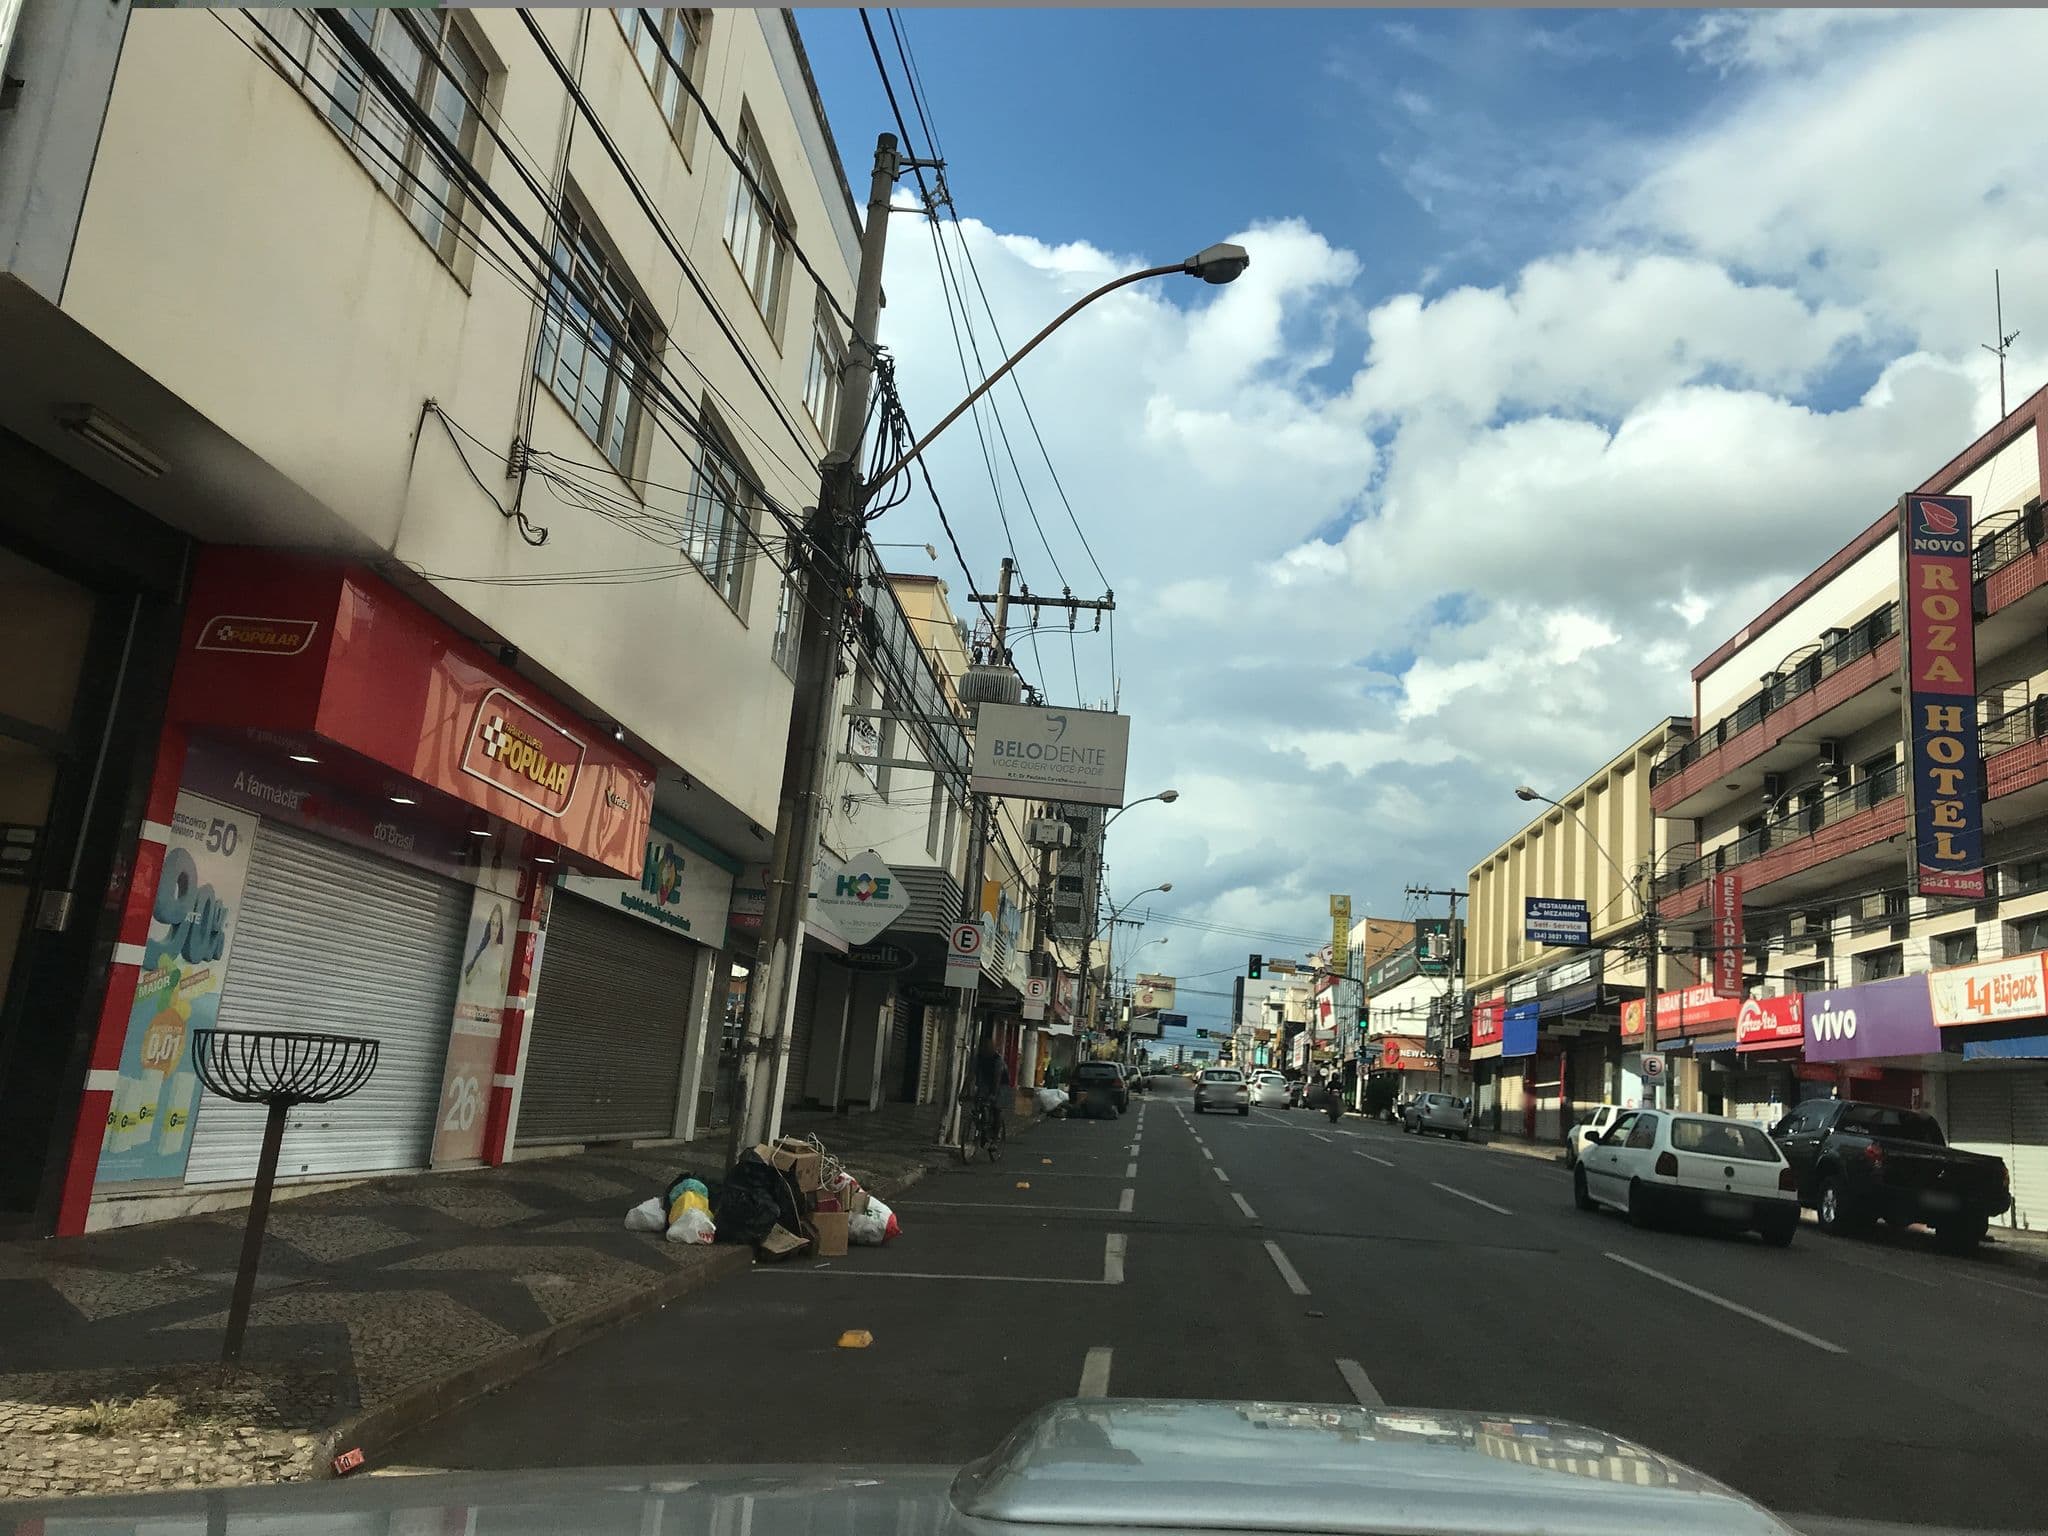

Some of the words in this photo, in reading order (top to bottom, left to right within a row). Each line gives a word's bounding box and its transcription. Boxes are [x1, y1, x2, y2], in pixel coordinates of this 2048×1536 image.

[1914, 539, 1966, 553] NOVO
[1920, 564, 1964, 682] ROZA
[498, 732, 569, 795] POPULAR
[993, 739, 1106, 766] BELODENTE
[234, 770, 245, 792] A
[249, 774, 299, 810] farmácia
[1924, 704, 1967, 861] HOTEL
[373, 821, 387, 841] do
[388, 825, 415, 850] Brasil
[1538, 903, 1585, 912] RESTAURANTE
[961, 930, 973, 949] E
[1723, 876, 1735, 989] RESTAURANTE
[1032, 983, 1039, 995] E
[1994, 974, 2038, 1008] Bijoux
[1811, 1000, 1857, 1042] vivo
[1649, 1060, 1657, 1072] E
